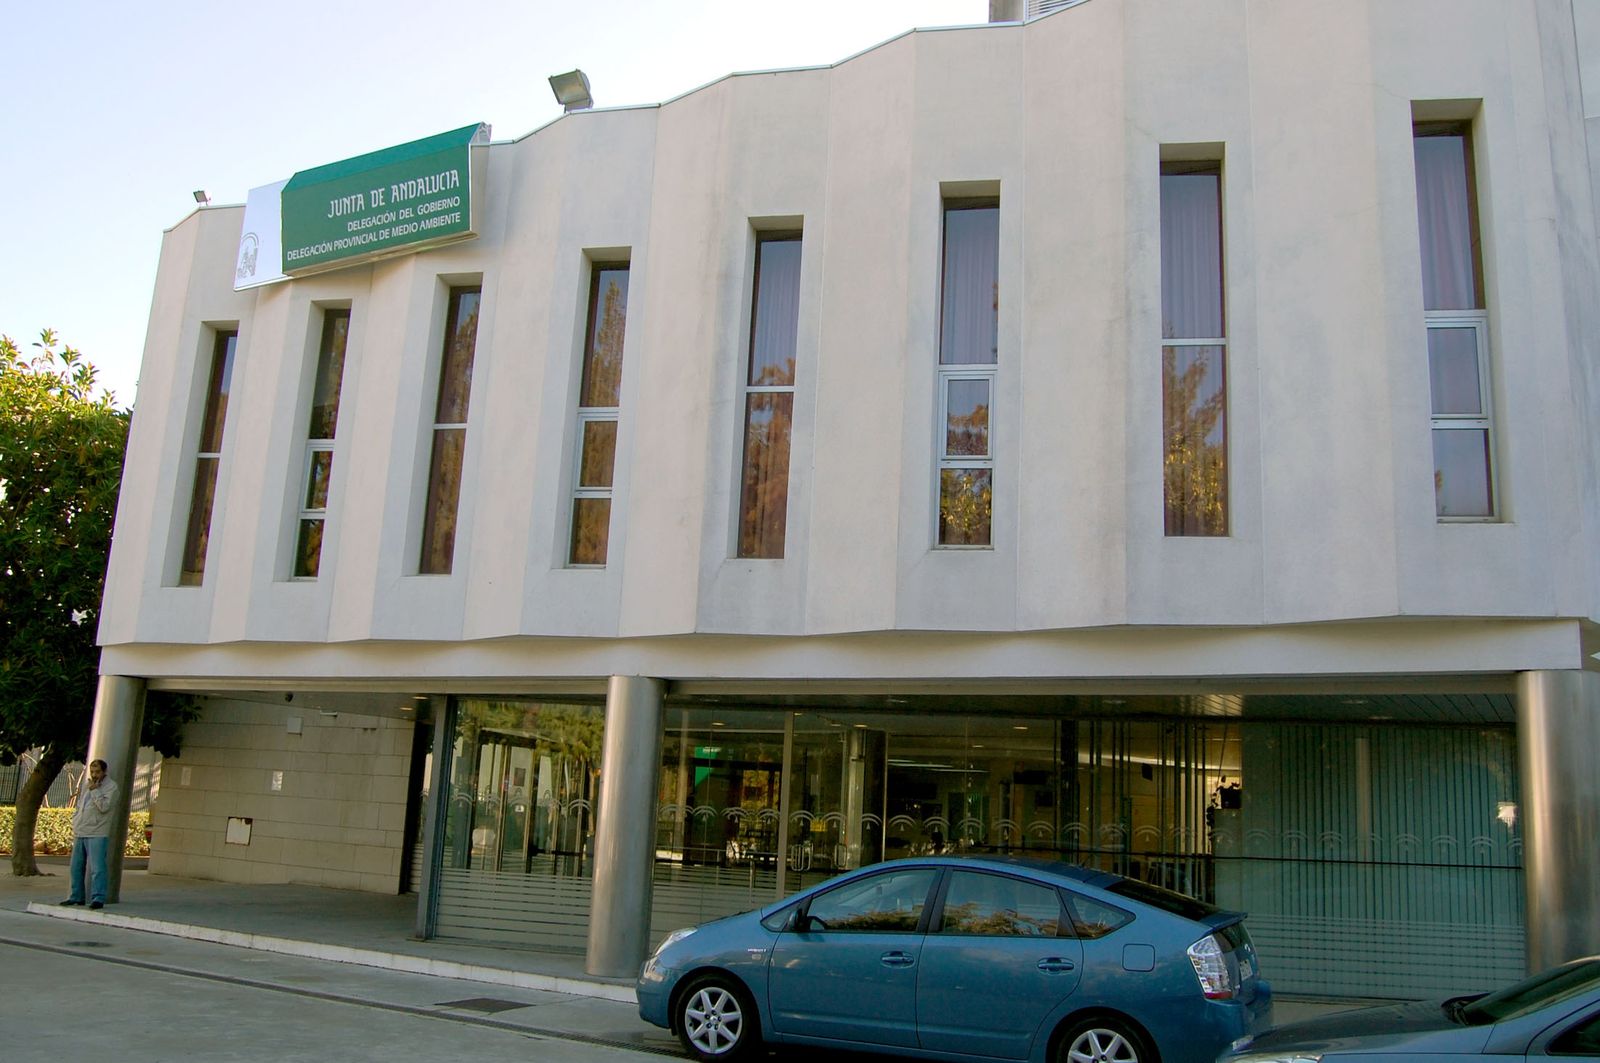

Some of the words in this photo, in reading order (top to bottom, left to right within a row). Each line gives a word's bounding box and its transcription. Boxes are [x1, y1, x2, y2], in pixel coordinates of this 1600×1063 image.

[328, 194, 365, 218] JUNTA
[370, 188, 385, 208] DE
[347, 211, 396, 232] DELEGACIÓN
[399, 207, 414, 220] DEL
[417, 196, 460, 215] GOBIERNO
[333, 228, 378, 251] PROVINCIAL
[379, 229, 390, 240] DE
[391, 222, 418, 237] MEDIO
[419, 212, 461, 230] AMBIENTE
